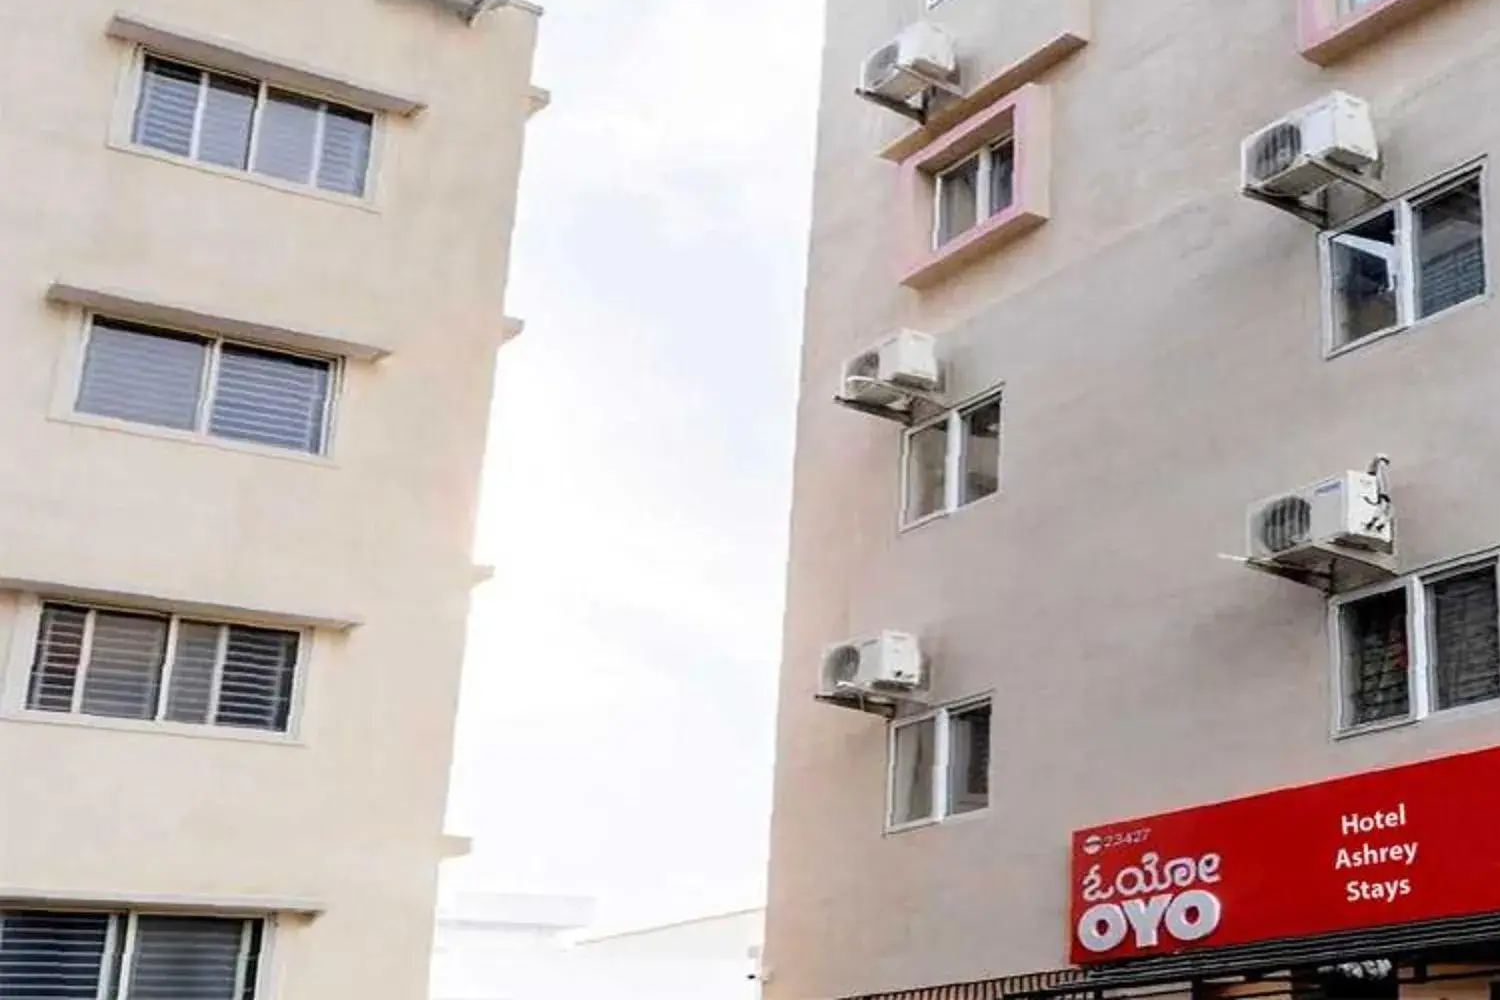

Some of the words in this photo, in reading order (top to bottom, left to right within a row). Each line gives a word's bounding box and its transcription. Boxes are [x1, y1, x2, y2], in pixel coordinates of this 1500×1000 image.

[1341, 802, 1406, 836] Hotel
[1335, 842, 1418, 869] Ashrey
[1346, 878, 1411, 903] Stays
[1077, 889, 1221, 952] OYO
